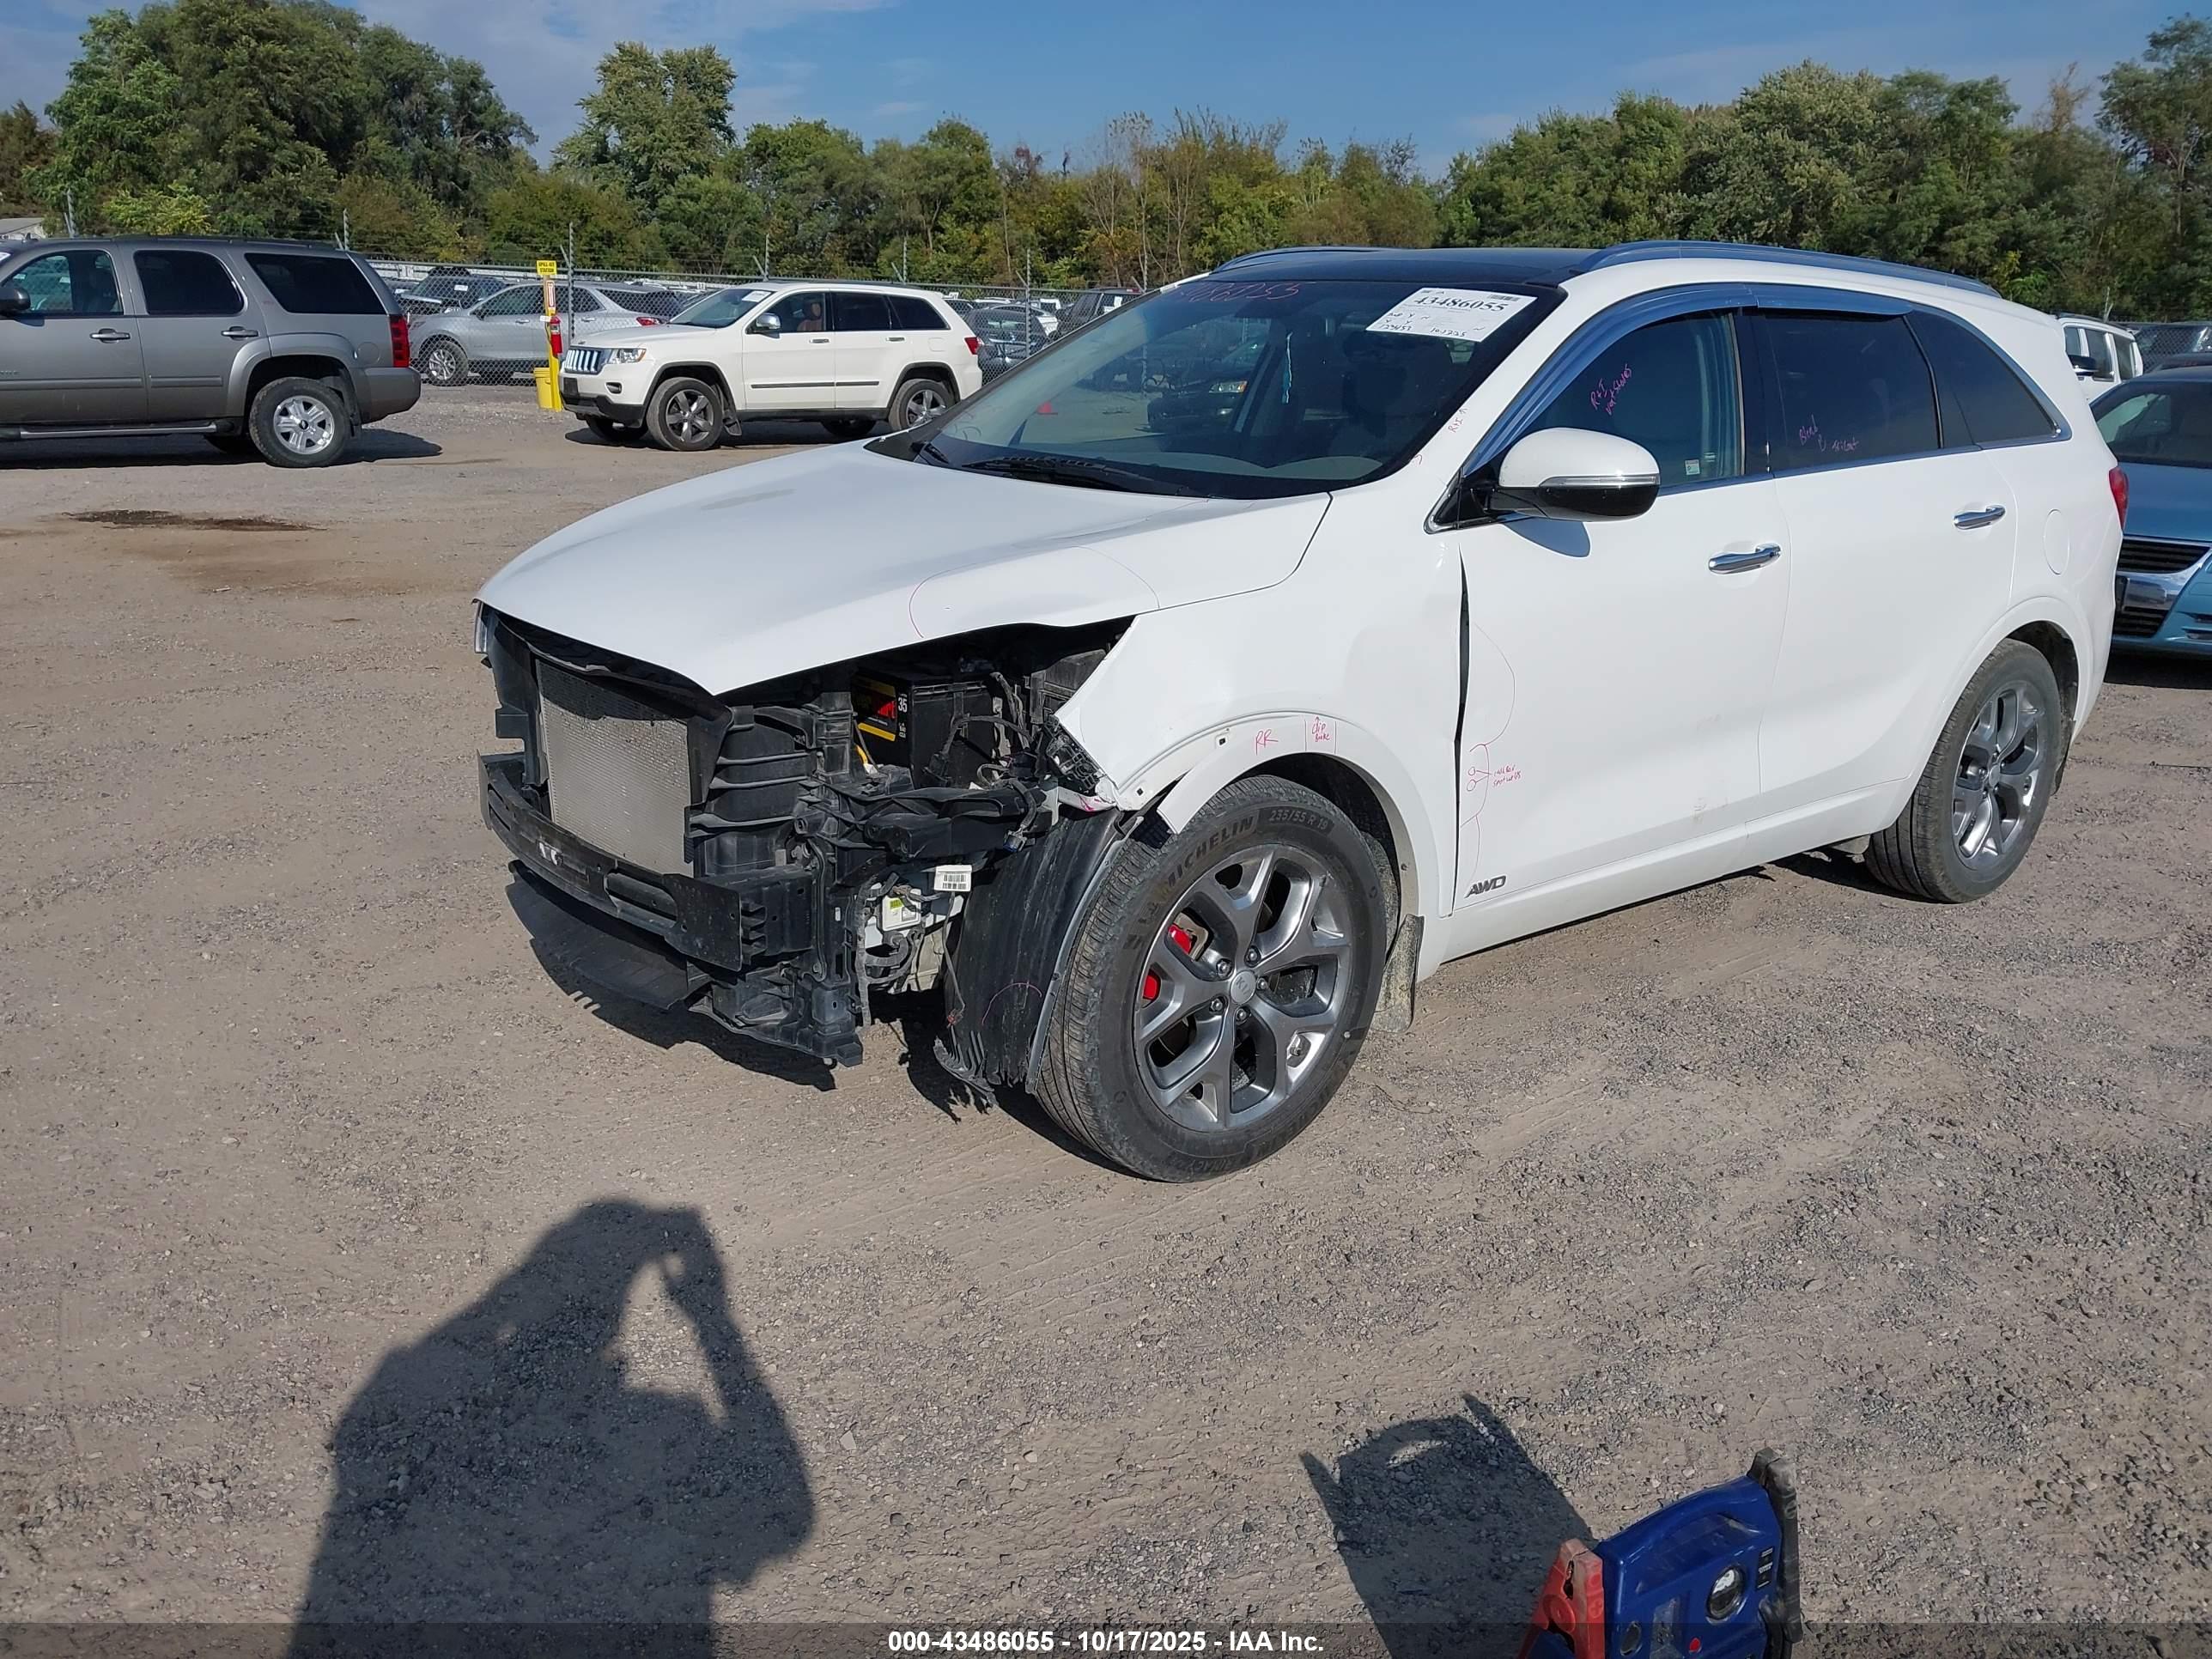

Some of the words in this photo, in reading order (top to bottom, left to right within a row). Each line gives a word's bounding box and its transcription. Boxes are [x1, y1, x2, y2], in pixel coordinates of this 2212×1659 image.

[1413, 296, 1509, 312] 43486055
[897, 697, 908, 713] 35
[1167, 816, 1255, 888] MICHELIN
[1268, 809, 1306, 825] 235/55
[1307, 814, 1316, 825] R
[1317, 817, 1328, 830] 19
[1464, 875, 1507, 899] AWD
